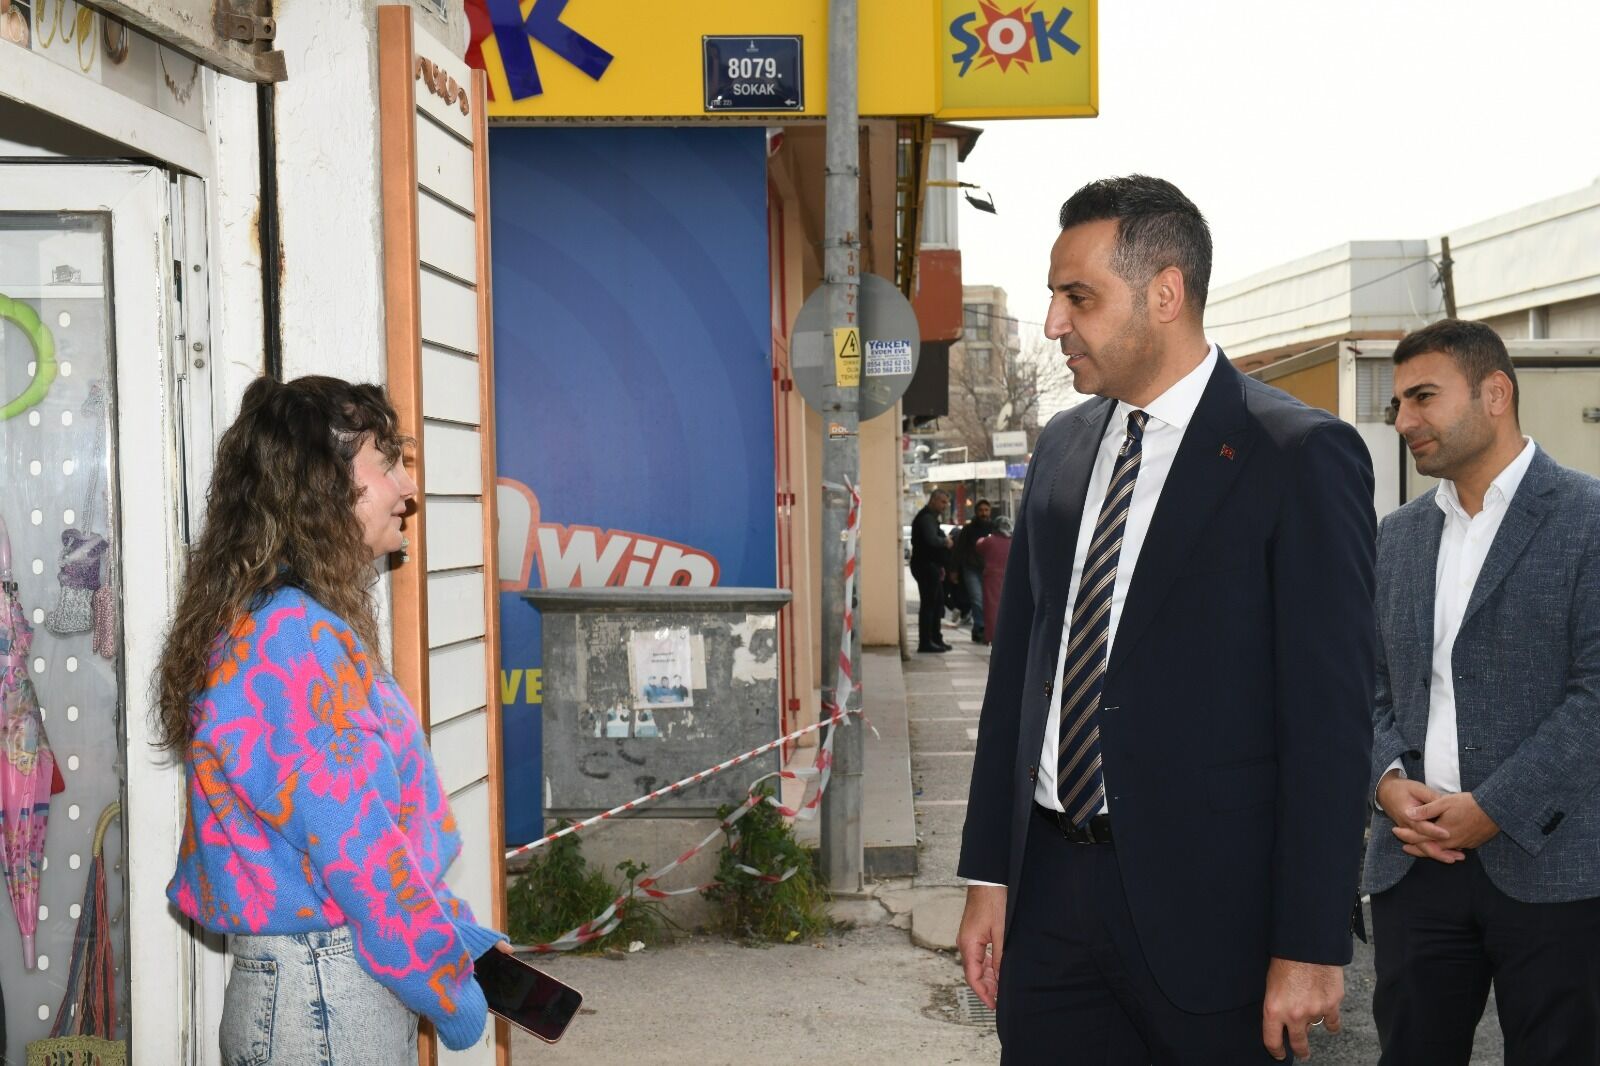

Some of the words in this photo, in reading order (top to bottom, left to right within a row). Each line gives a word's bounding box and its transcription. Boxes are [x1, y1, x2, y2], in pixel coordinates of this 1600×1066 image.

[949, 6, 1081, 78] ŞOK
[728, 58, 782, 78] 8079.
[733, 84, 775, 95] SOKAK
[501, 669, 542, 704] VE
